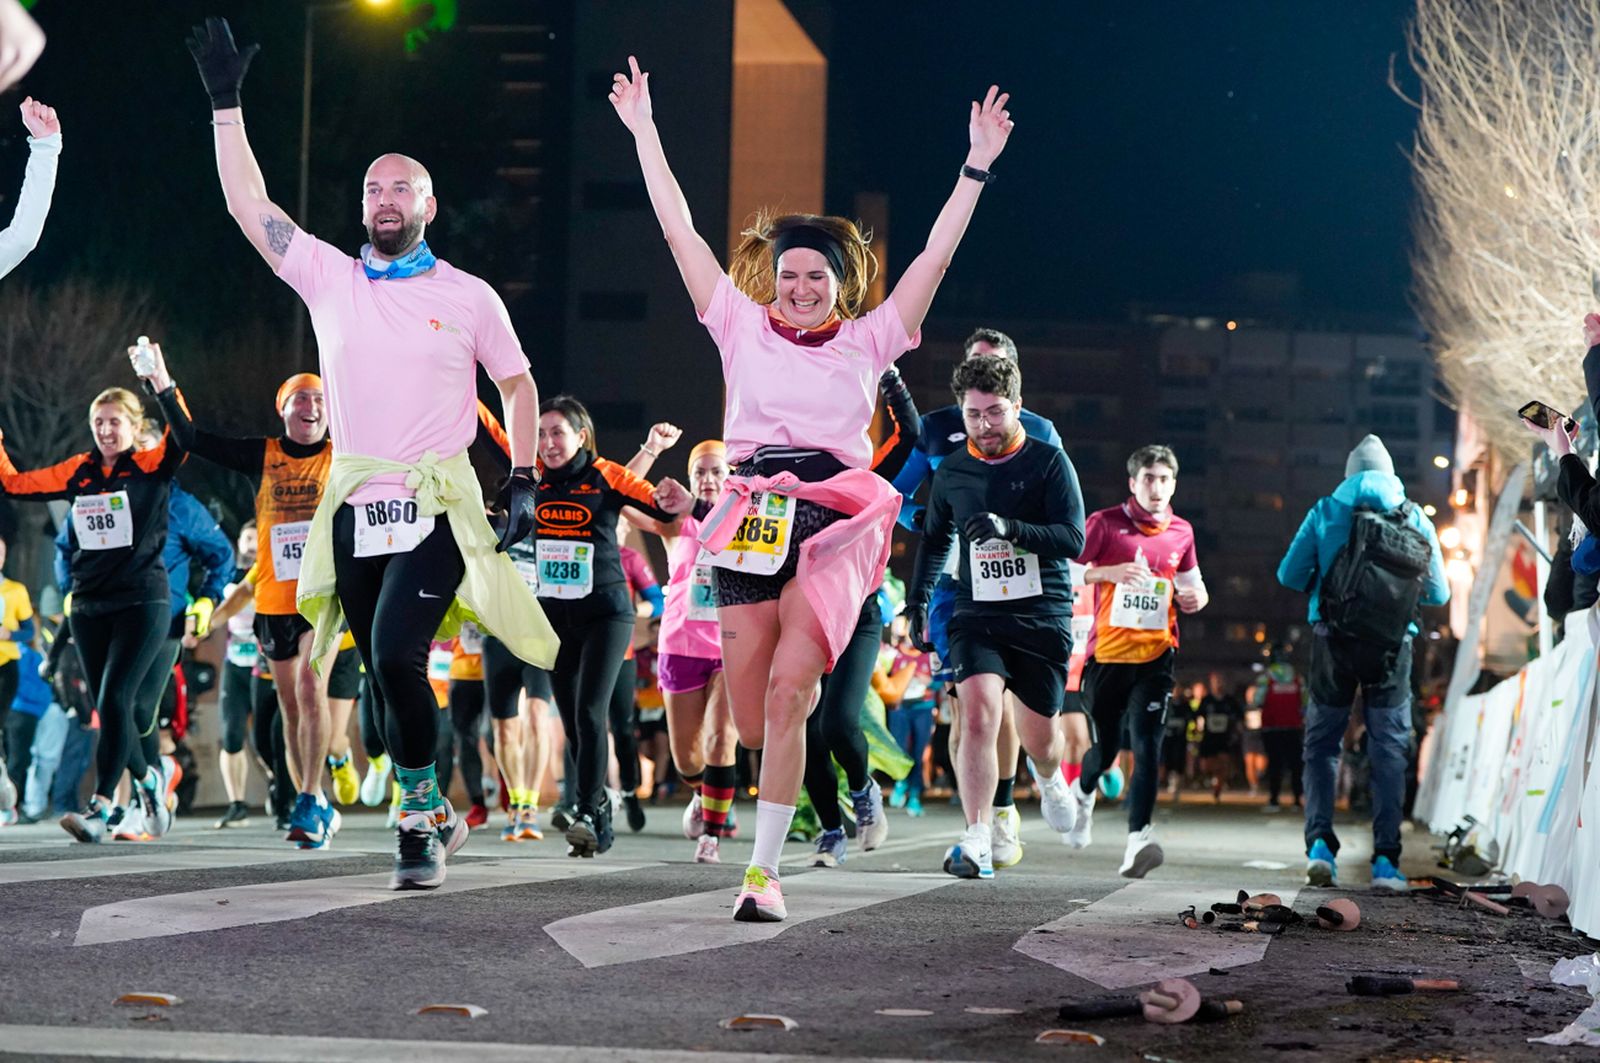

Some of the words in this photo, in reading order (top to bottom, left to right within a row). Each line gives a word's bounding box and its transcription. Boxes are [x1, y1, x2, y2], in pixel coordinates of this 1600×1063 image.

[86, 513, 115, 531] 388
[365, 499, 418, 527] 6860
[541, 509, 583, 521] GALBIS
[732, 517, 779, 544] 885
[282, 542, 305, 560] 45
[544, 561, 580, 579] 4238
[980, 557, 1026, 579] 3968
[1123, 594, 1159, 611] 5465
